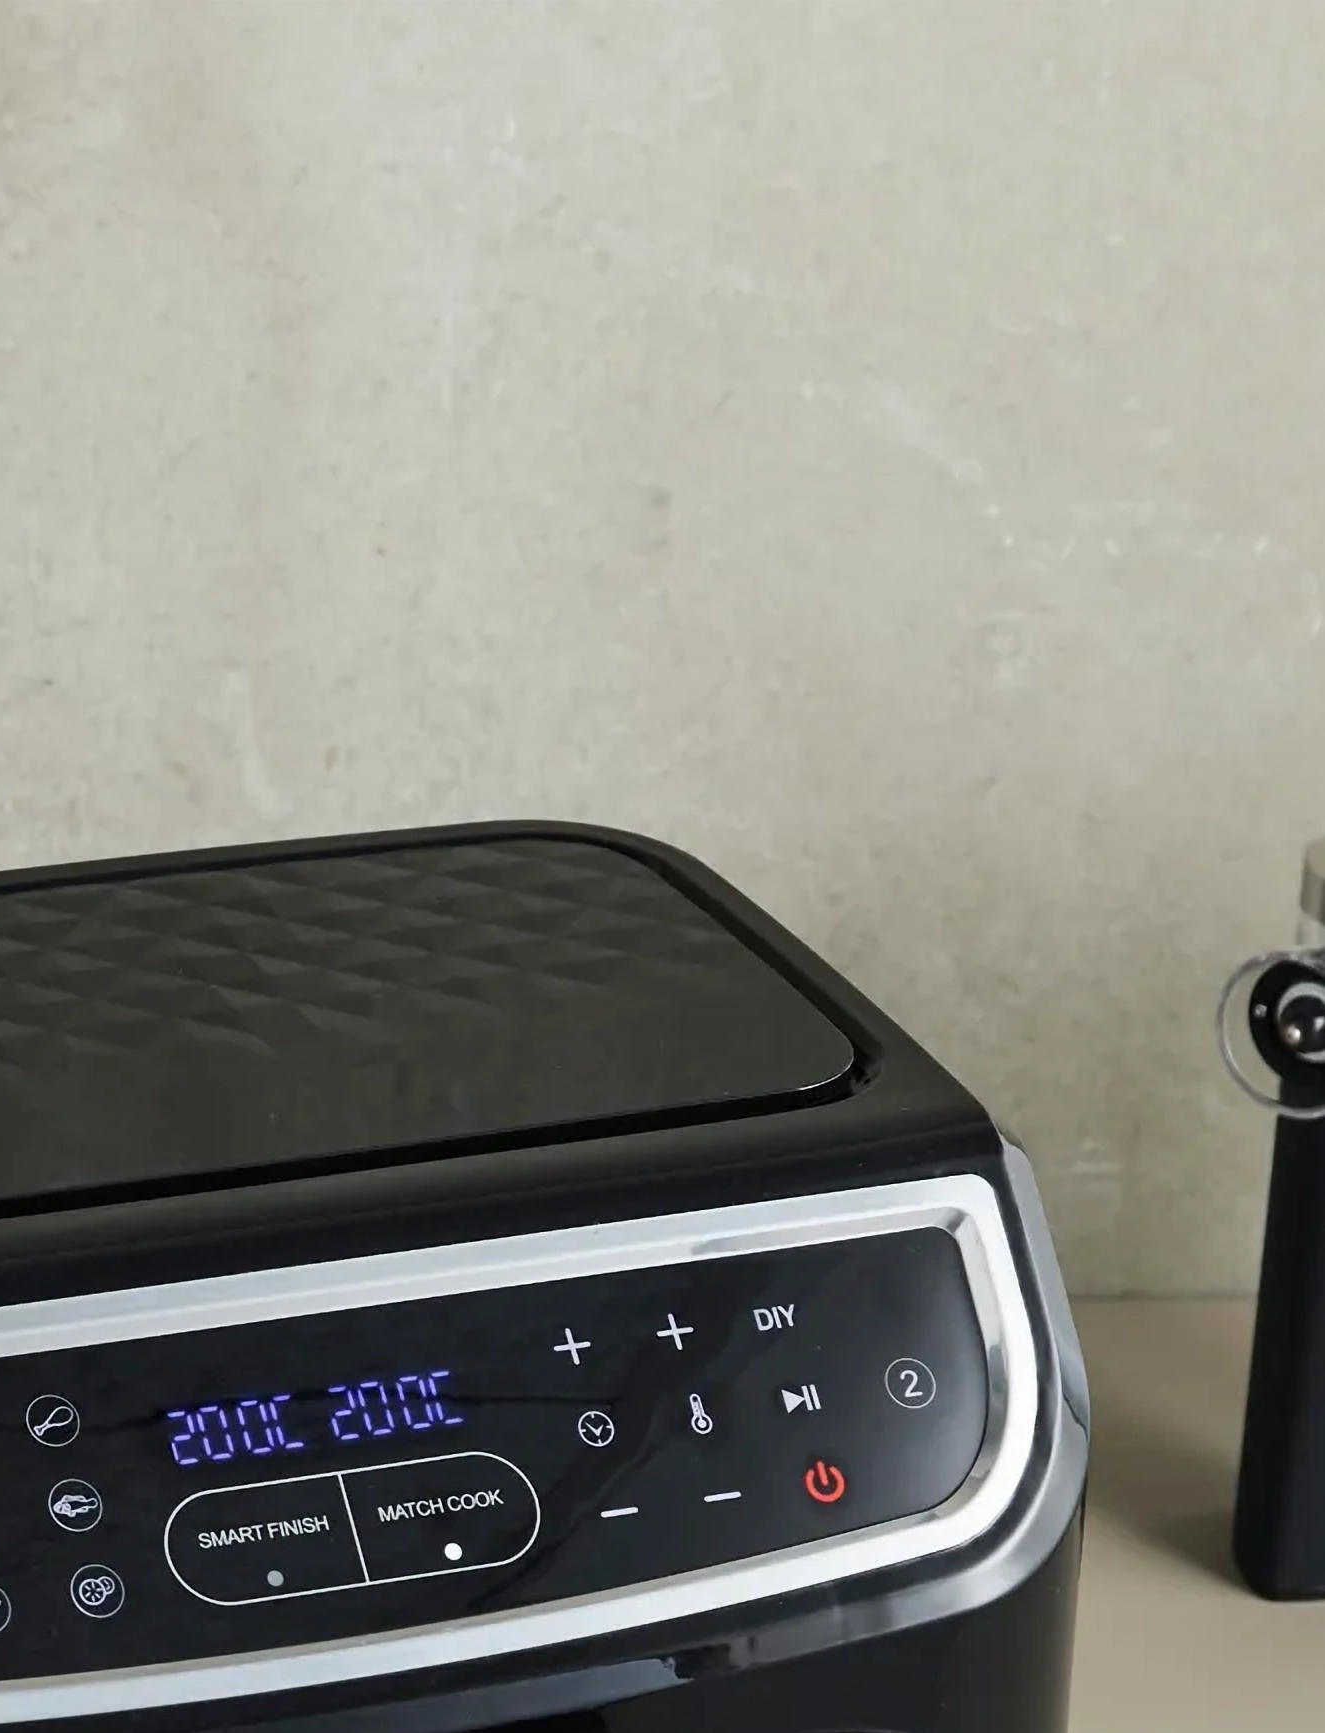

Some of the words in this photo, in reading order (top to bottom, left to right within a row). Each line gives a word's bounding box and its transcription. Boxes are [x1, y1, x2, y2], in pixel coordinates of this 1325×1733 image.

[753, 1304, 795, 1331] DIY
[899, 1370, 923, 1397] 2
[377, 1498, 444, 1523] MATCH
[447, 1488, 504, 1512] COOK
[198, 1524, 264, 1549] SMART
[267, 1514, 330, 1539] FINISH
